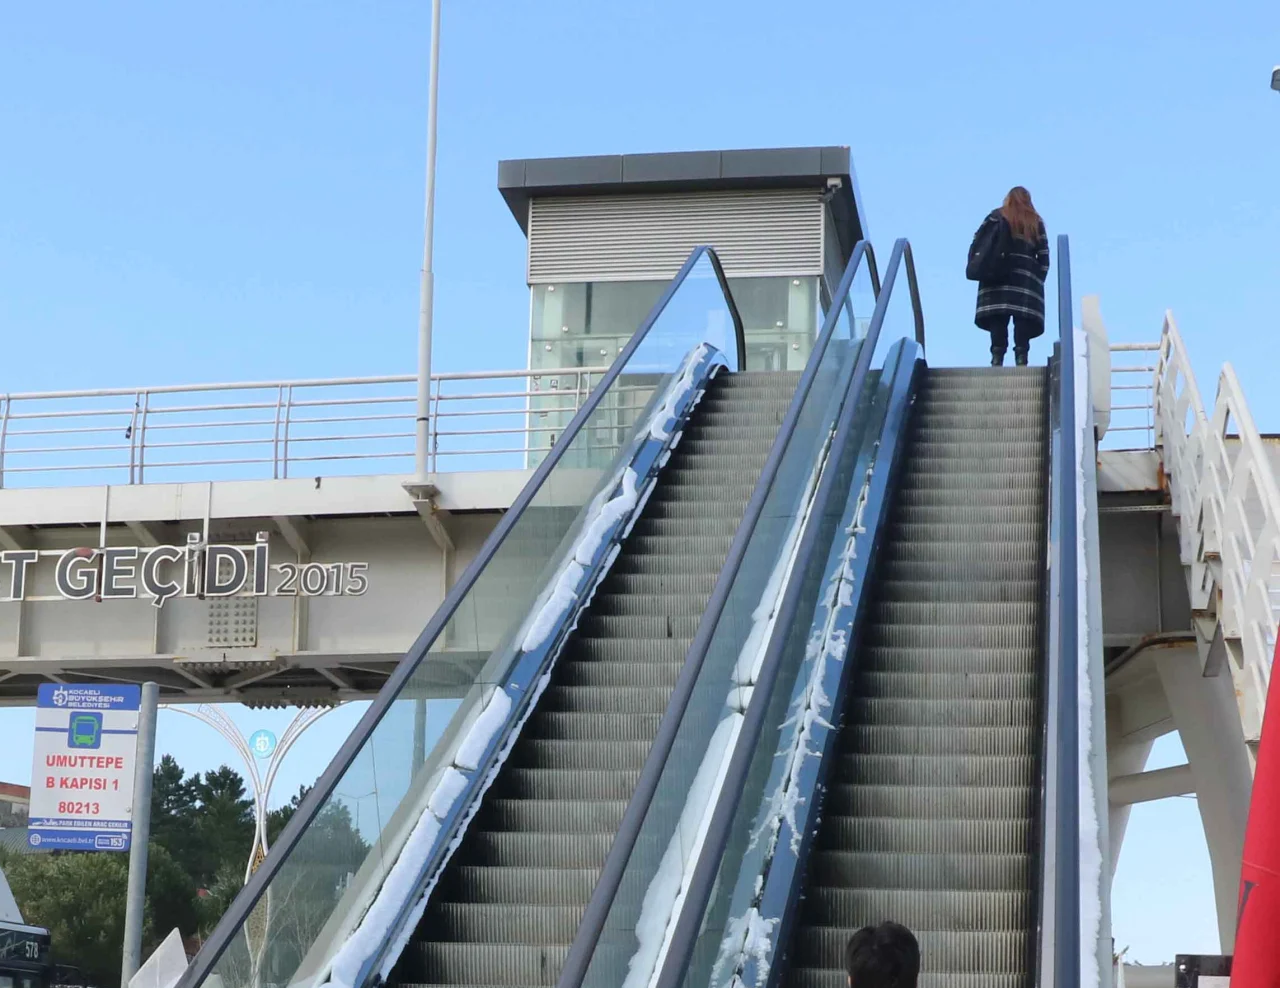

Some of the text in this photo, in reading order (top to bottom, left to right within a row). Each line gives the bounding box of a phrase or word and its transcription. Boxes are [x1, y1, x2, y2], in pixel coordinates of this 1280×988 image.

[55, 531, 269, 608] GEÇİDİ
[275, 562, 369, 597] 2015
[46, 755, 124, 769] UMUTTEPE
[46, 776, 119, 791] B KAPISI 1
[58, 801, 100, 814] 80213
[25, 940, 39, 958] 578
